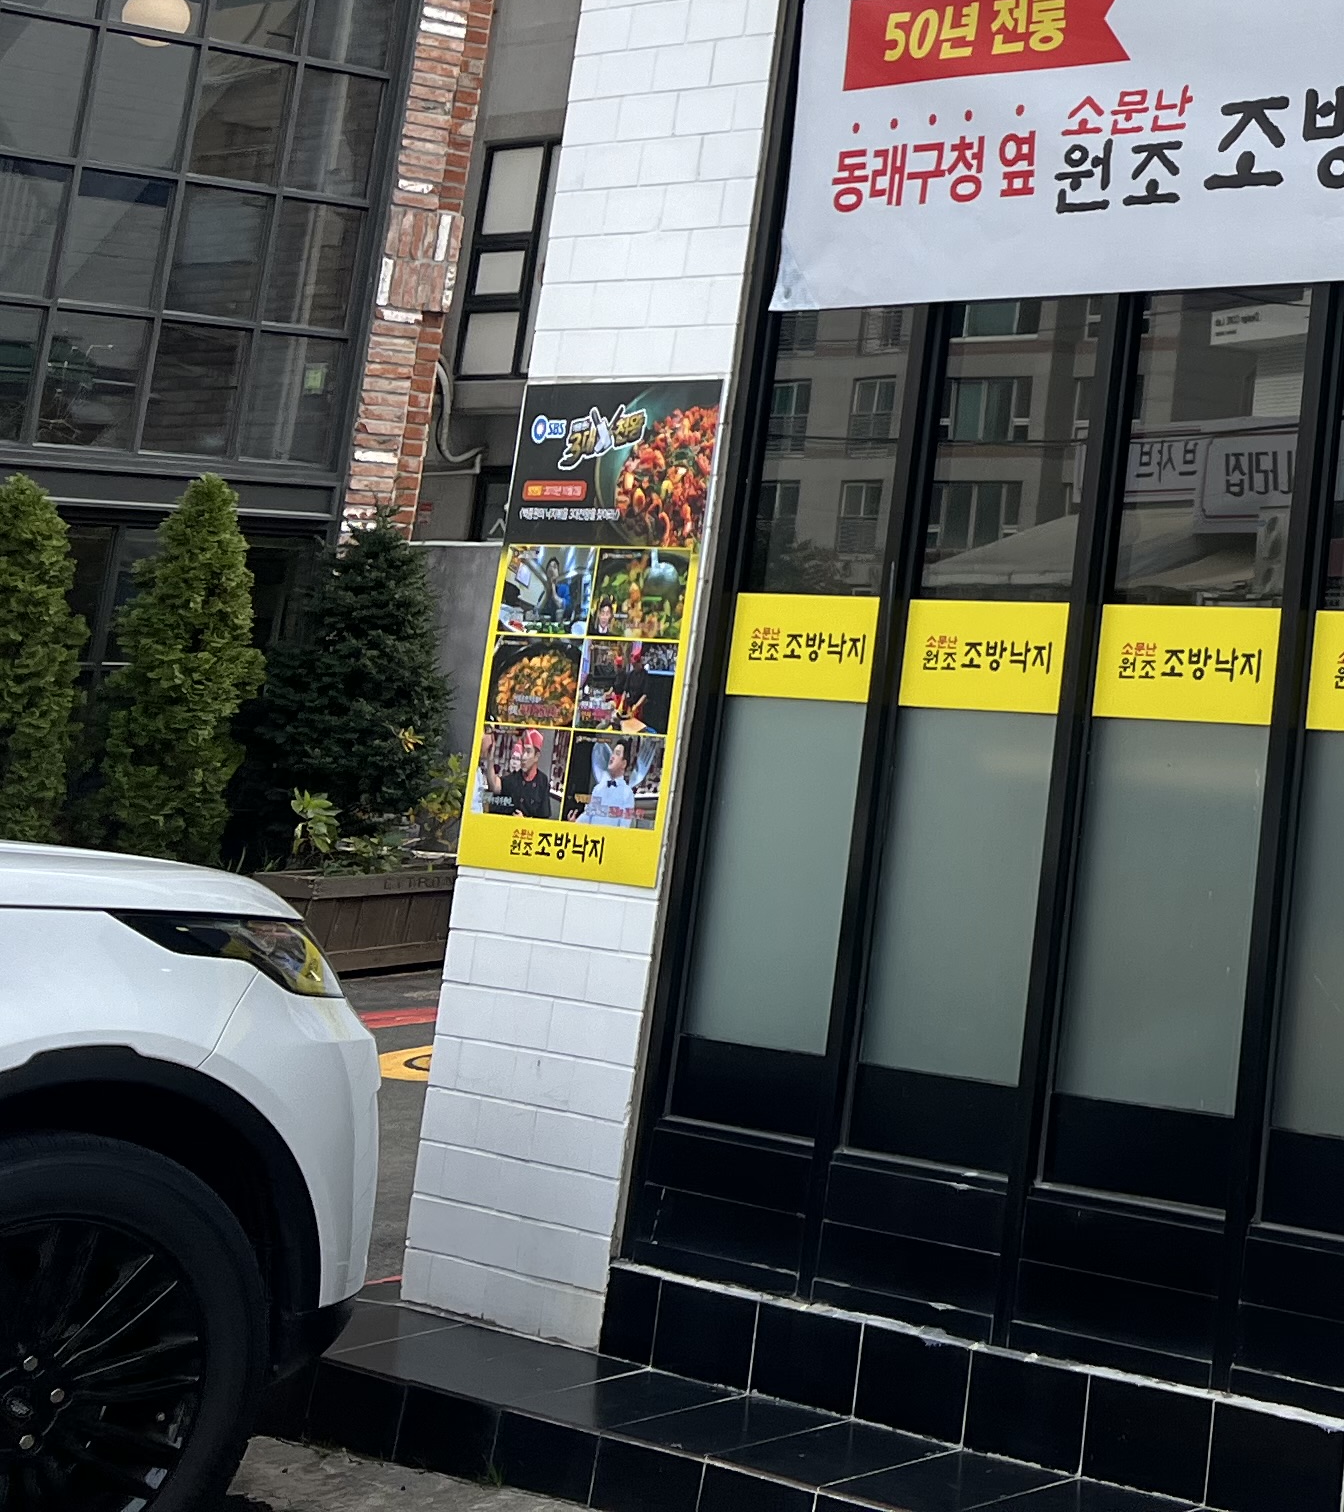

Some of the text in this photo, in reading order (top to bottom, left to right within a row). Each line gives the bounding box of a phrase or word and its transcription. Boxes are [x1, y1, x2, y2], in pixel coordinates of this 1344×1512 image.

[883, 0, 980, 62] 50년
[1061, 85, 1194, 137] 소문난
[831, 134, 985, 213] 동래구청
[999, 130, 1037, 198] 옆
[1054, 138, 1184, 214] 원조
[547, 420, 566, 436] SBS
[748, 632, 867, 665] 원조 조방낙지
[751, 627, 781, 641] 소문난
[925, 635, 958, 650] 소문난
[1120, 641, 1158, 657] 소문난
[922, 639, 1053, 675] 원조 조방낙지
[1117, 647, 1263, 683] 원조 조방낙지
[509, 831, 606, 865] 원조 조방낙지
